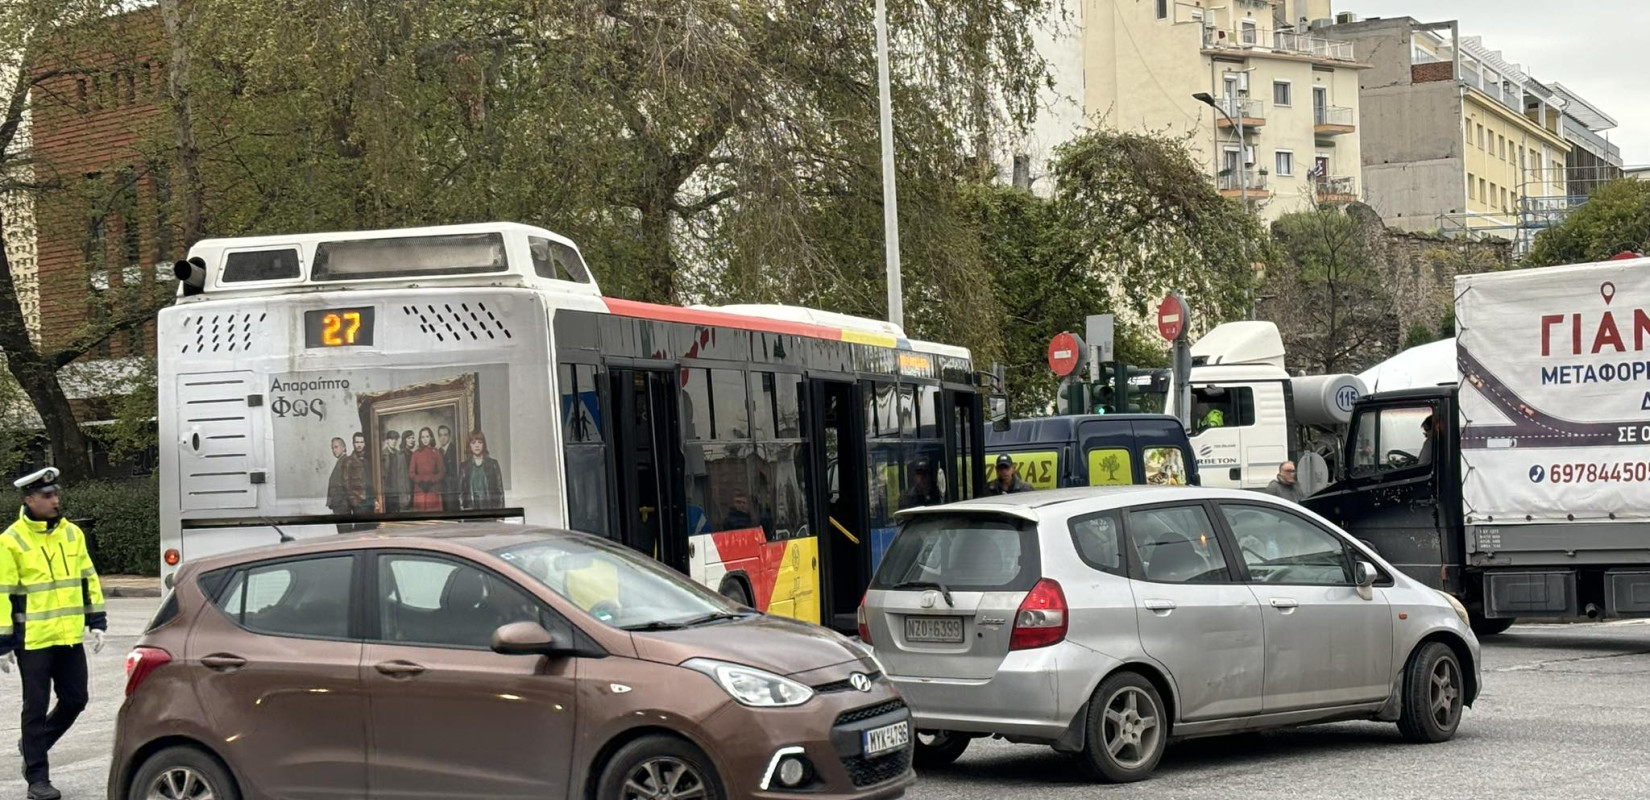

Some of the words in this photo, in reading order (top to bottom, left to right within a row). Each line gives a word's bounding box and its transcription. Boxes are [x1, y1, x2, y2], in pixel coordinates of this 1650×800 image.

[322, 312, 361, 346] 27
[271, 376, 350, 395] Απαραίτητο
[1339, 391, 1356, 407] 115
[1618, 426, 1637, 443] ΣΕ
[1550, 461, 1650, 484] 69784450
